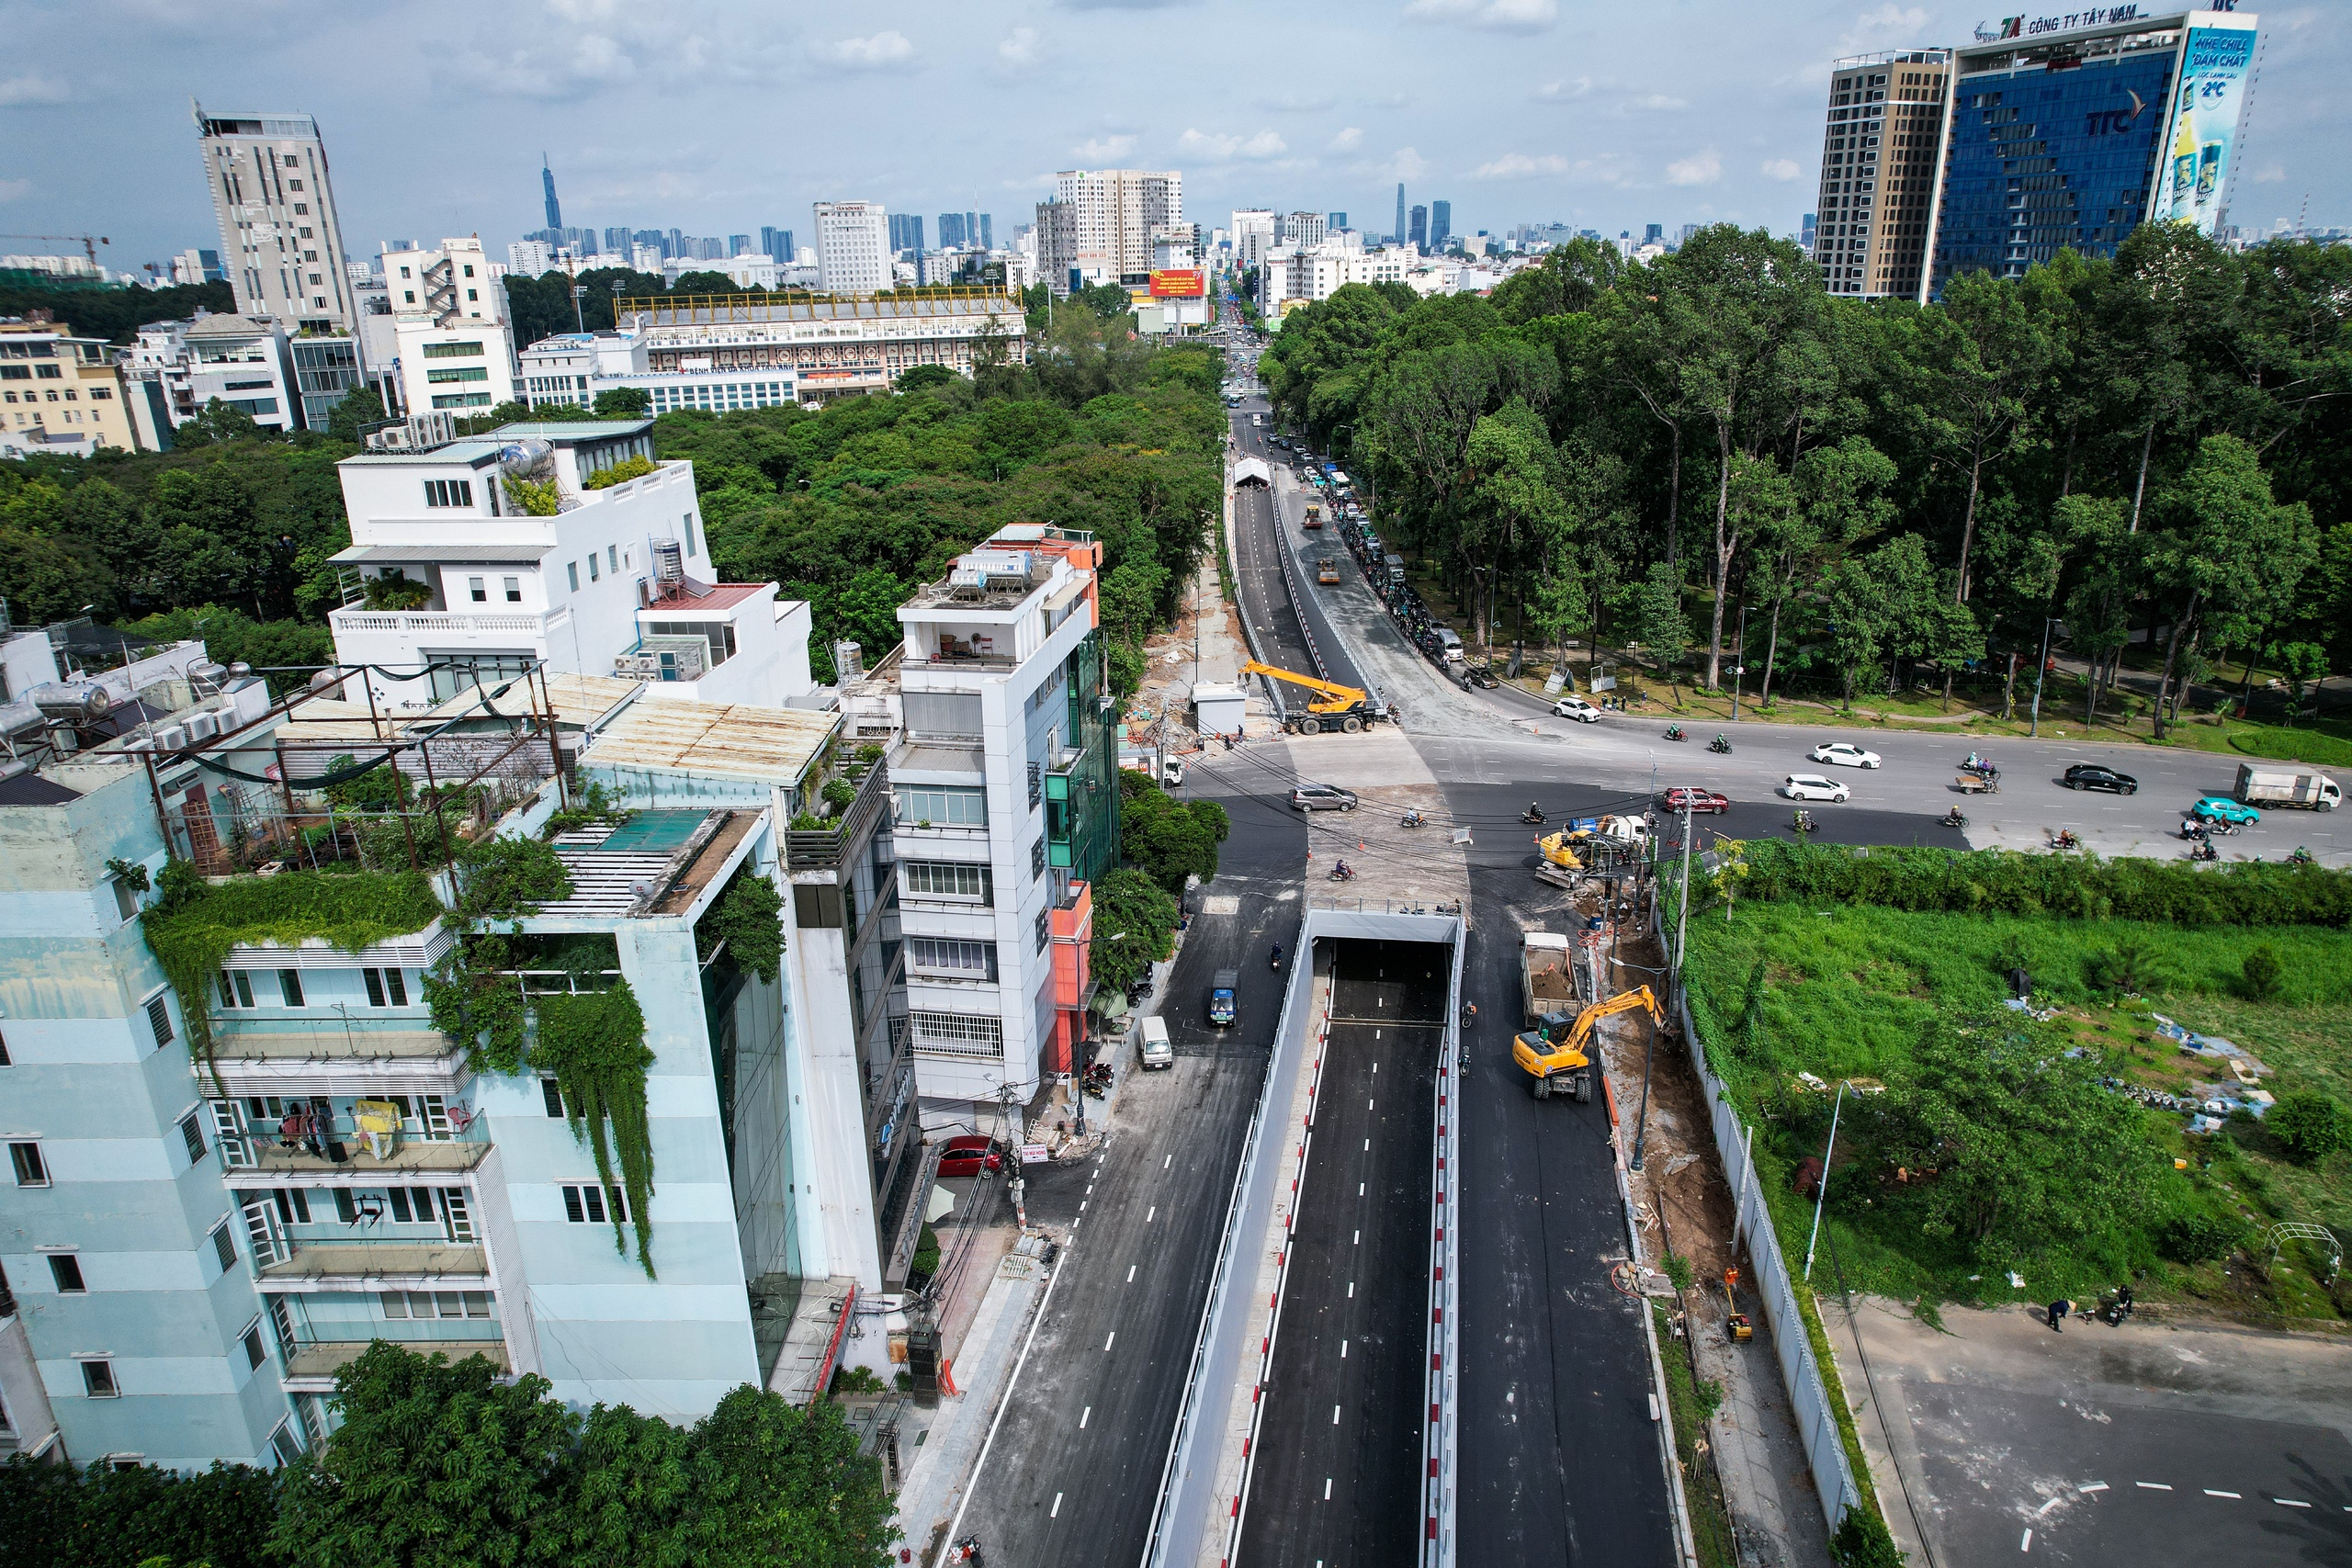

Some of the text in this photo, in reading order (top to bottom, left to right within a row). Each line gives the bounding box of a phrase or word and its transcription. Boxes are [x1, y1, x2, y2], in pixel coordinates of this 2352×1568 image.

[2029, 4, 2138, 34] CÔNG TY TÂY NAM
[2220, 37, 2247, 51] CHILL
[2086, 108, 2132, 136] TTC
